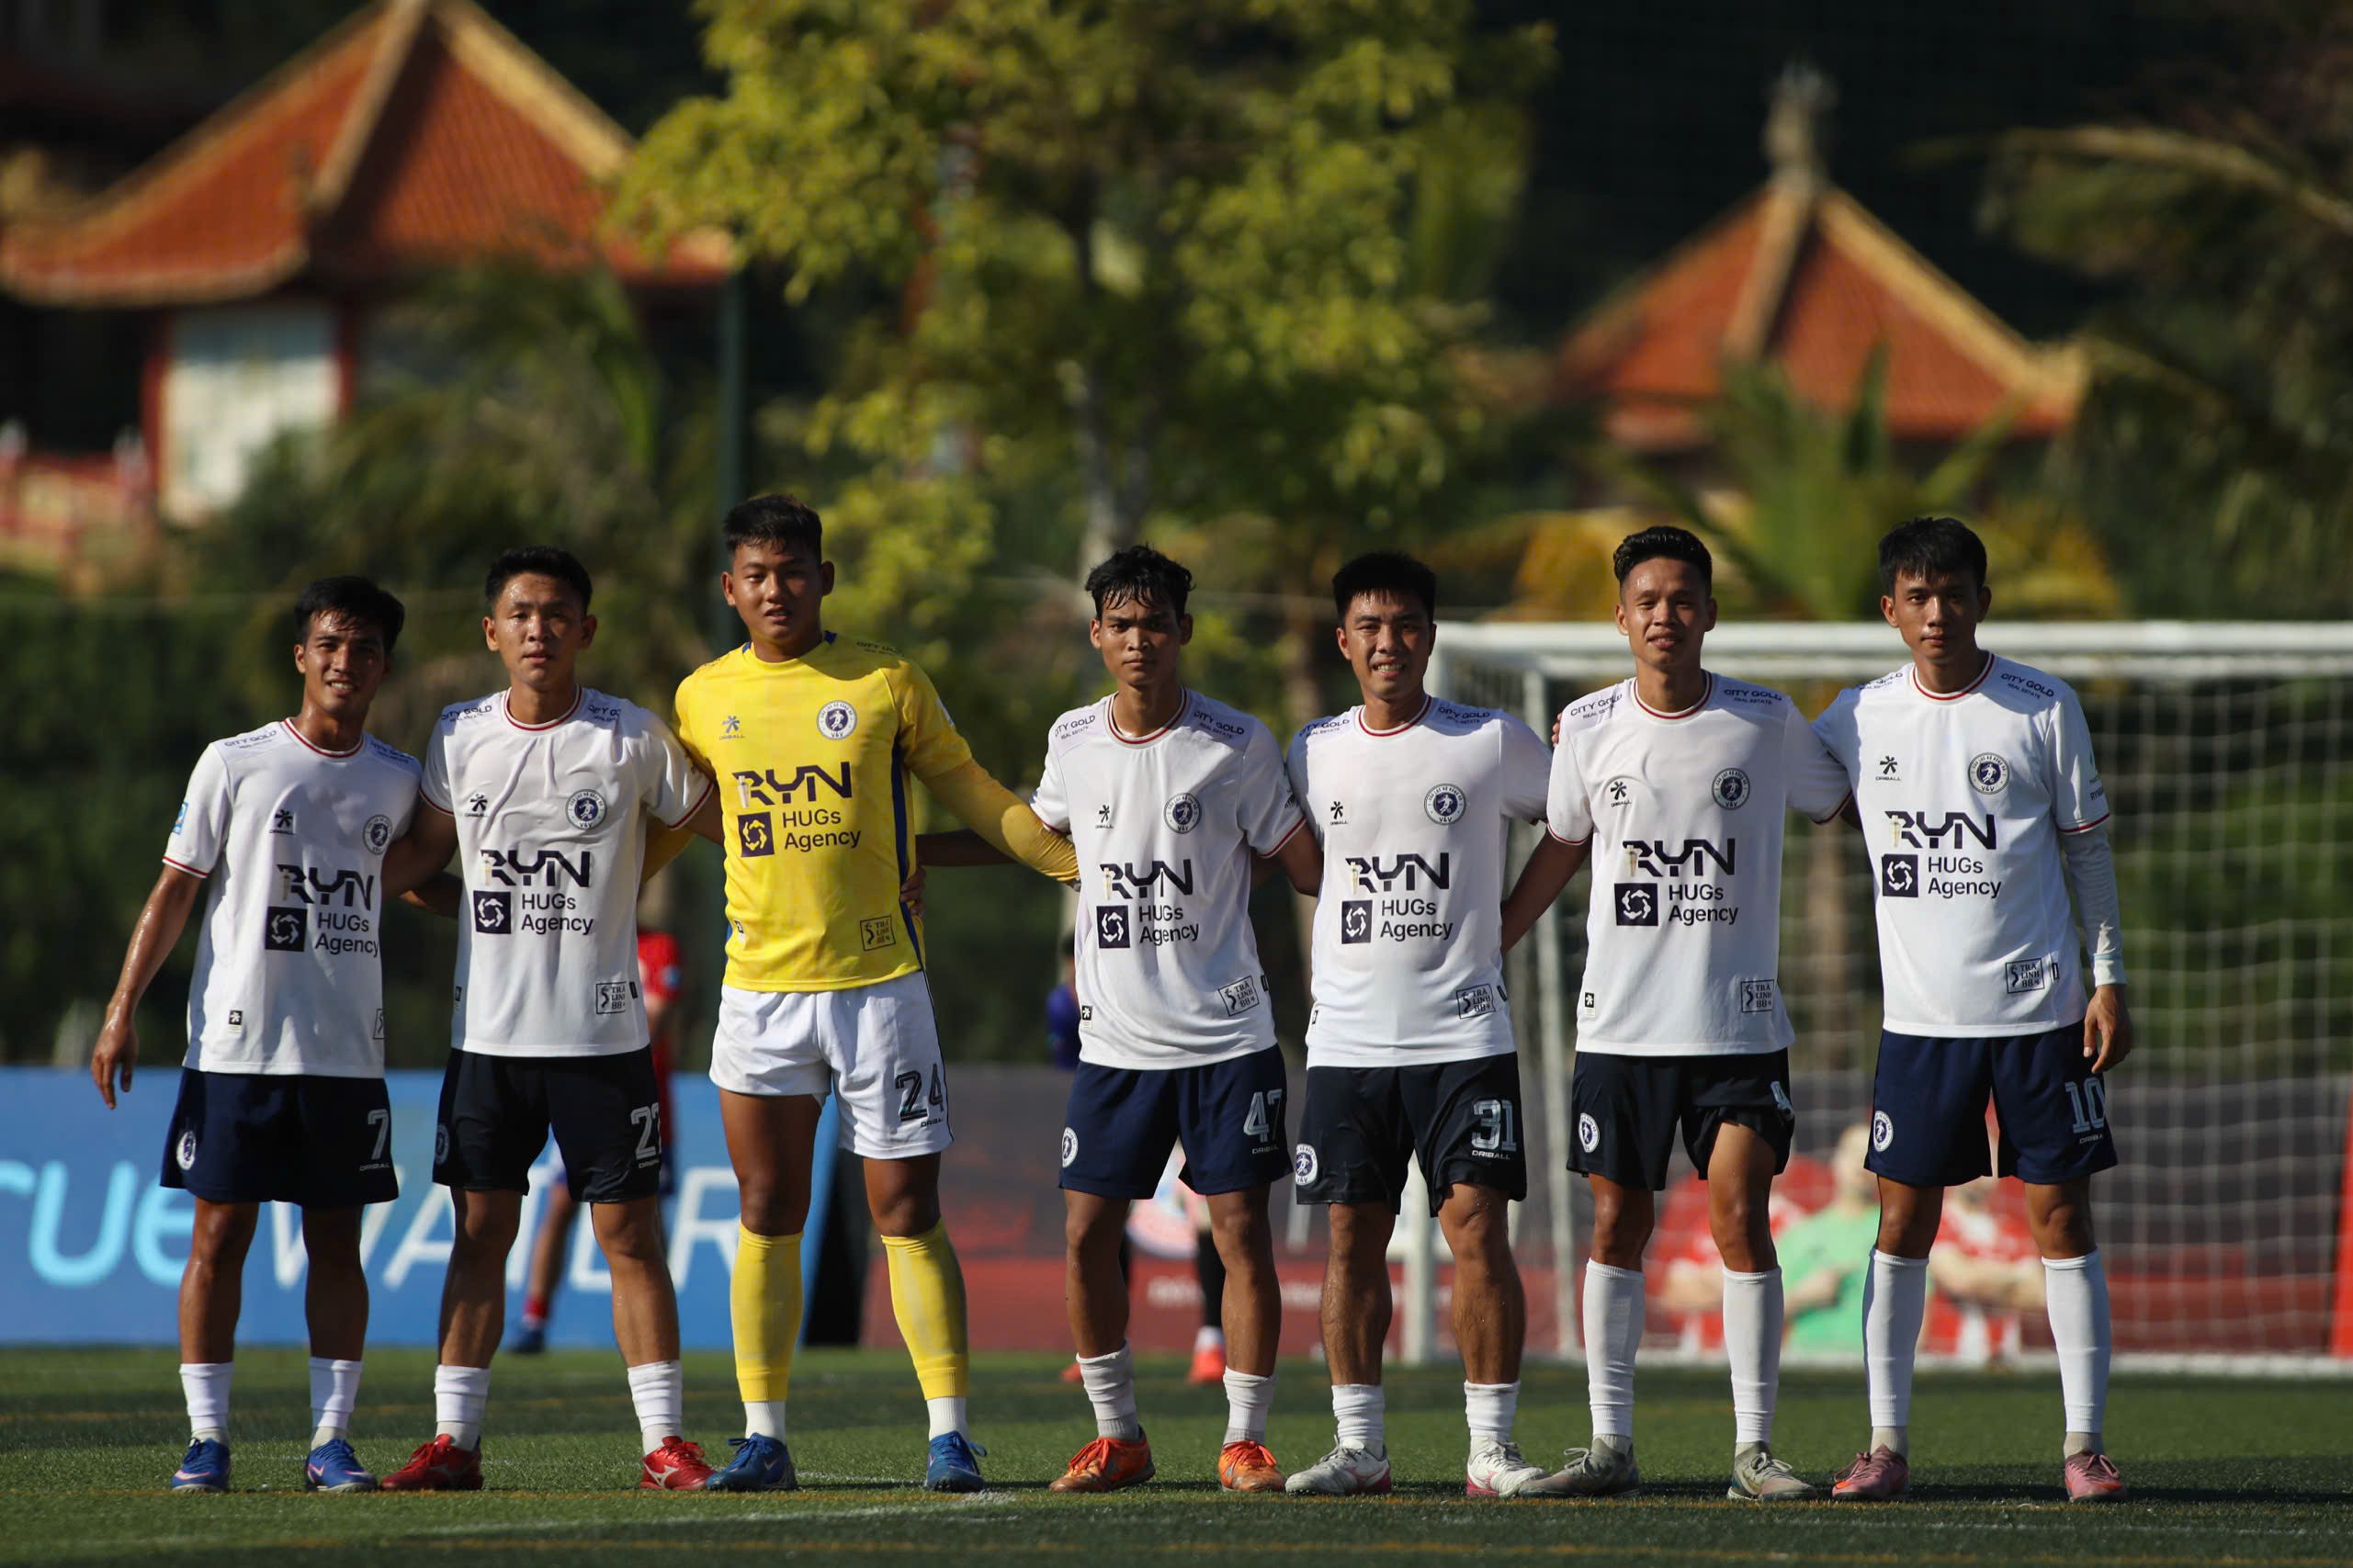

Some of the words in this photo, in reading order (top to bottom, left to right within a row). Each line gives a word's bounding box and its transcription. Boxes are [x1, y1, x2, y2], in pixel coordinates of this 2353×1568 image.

[2001, 673, 2025, 683] CITY
[2026, 680, 2054, 697] GOLD
[463, 705, 492, 714] GOLD
[1571, 702, 1595, 716] CITY
[1070, 715, 1096, 728] GOLD
[1216, 722, 1245, 735] GOLD
[1321, 719, 1350, 728] GOLD
[732, 761, 853, 808] RYN
[782, 808, 842, 828] HUGs
[784, 829, 862, 852] Agency
[1885, 811, 1997, 850] RYN
[1622, 838, 1736, 877] RYN
[1928, 857, 1984, 874] HUGs
[481, 850, 591, 888] RYN
[1099, 859, 1193, 900] RYN
[1345, 852, 1450, 893] RYN
[277, 864, 376, 911] RYN
[1669, 884, 1724, 900] HUGs
[1928, 878, 2002, 898] Agency
[522, 893, 576, 910] HUGs
[1381, 899, 1436, 916] HUGs
[317, 912, 370, 933] HUGs
[1138, 905, 1183, 922] HUGs
[1668, 906, 1738, 926] Agency
[521, 914, 594, 935] Agency
[1138, 922, 1200, 946] Agency
[1380, 920, 1453, 942] Agency
[314, 932, 380, 958] Agency
[895, 1063, 945, 1122] 24
[2065, 1077, 2106, 1134] 10
[368, 1109, 389, 1160] 7
[1471, 1100, 1516, 1151] 31
[1472, 1150, 1511, 1160] DRIBALL
